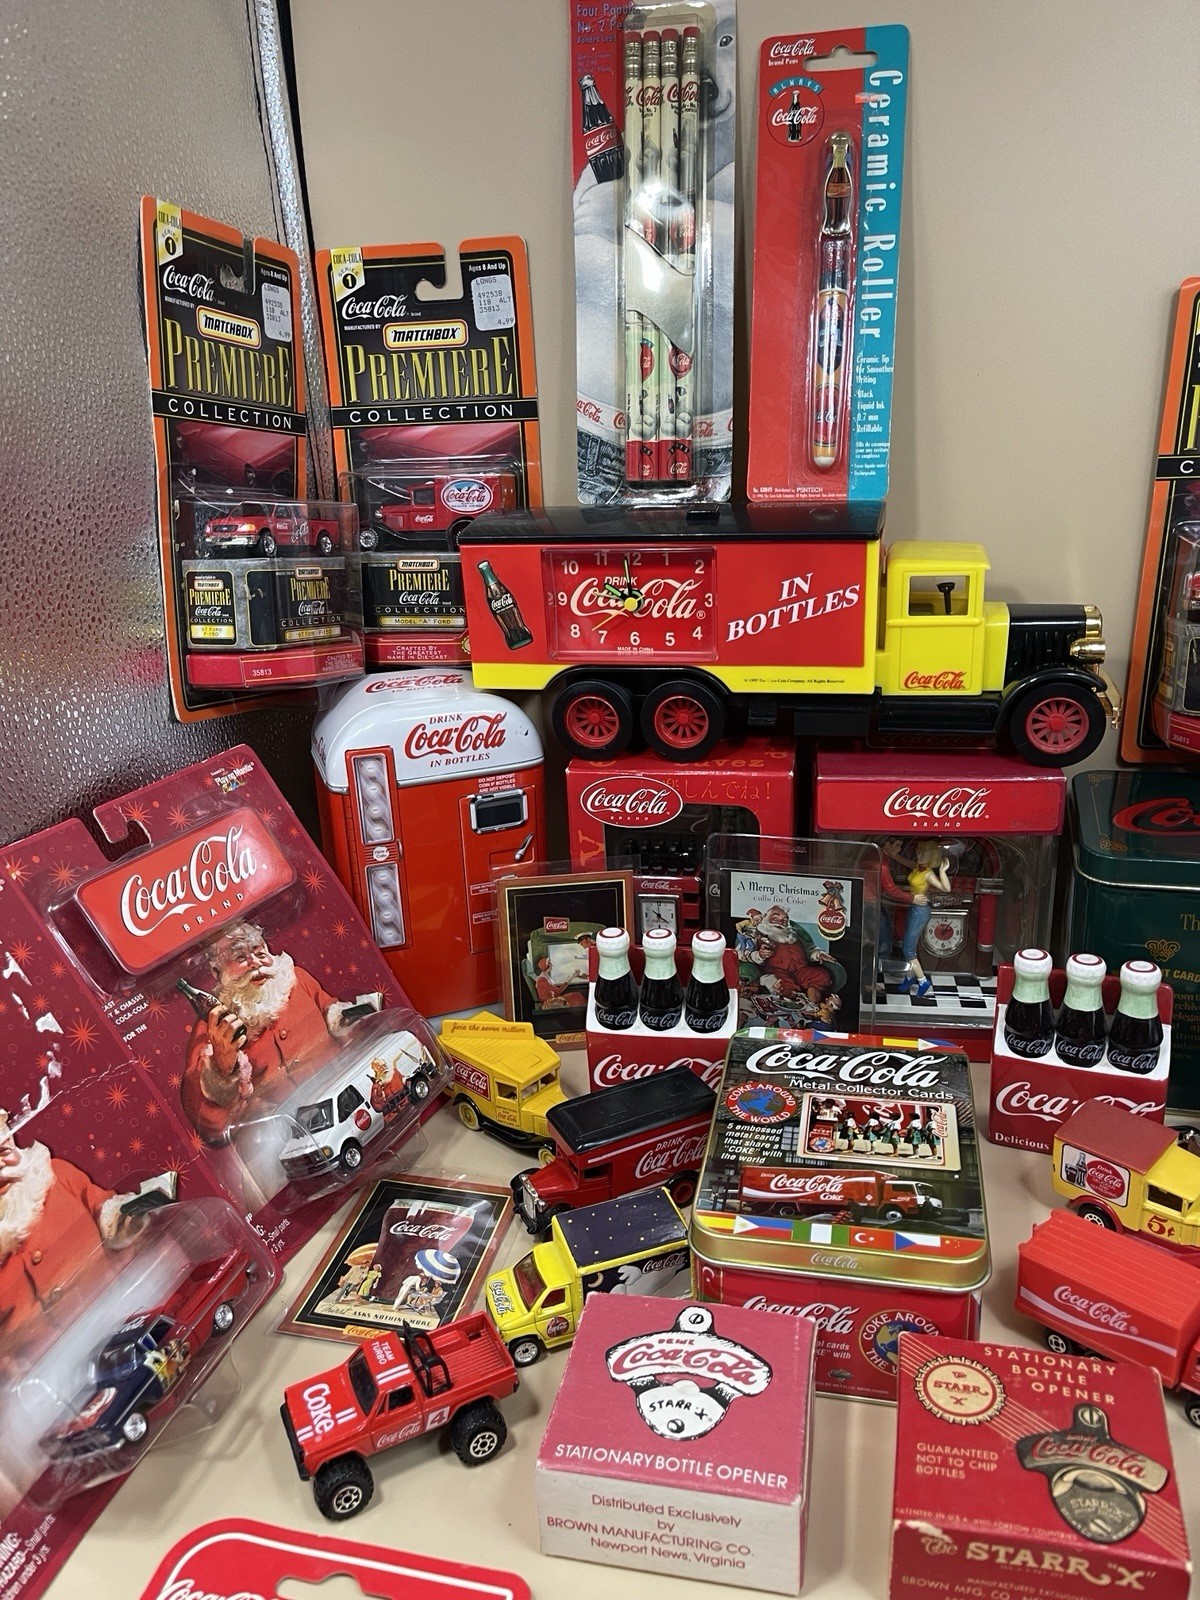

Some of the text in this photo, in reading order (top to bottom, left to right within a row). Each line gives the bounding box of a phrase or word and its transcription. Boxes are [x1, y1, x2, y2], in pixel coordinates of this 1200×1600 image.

[576, 5, 598, 17] Four
[770, 38, 816, 58] Coca-Cola
[773, 78, 819, 95] ALWAYS
[771, 106, 819, 127] Coca-Cola
[860, 70, 904, 339] Ceramic Roller
[332, 253, 363, 265] COCA-COLA
[468, 262, 506, 272] Ages And Up
[163, 264, 215, 303] Coca-Cola
[475, 276, 498, 286] LONGS
[477, 290, 503, 299] 492538
[478, 296, 512, 306] 118 ALT
[341, 294, 408, 320] Coca-Cola
[479, 305, 501, 314] 35813
[202, 313, 254, 340] MATCHBOX
[497, 317, 515, 326] 4.99
[279, 331, 291, 339] 4.99
[391, 327, 458, 343] MATCHBOX
[164, 318, 293, 407] PREMIERE
[856, 355, 880, 364] Ceramic
[343, 336, 514, 403] PREMIERE
[866, 365, 895, 374] Smoother
[855, 375, 877, 385] Writing
[857, 389, 874, 399] Black
[857, 401, 885, 410] Liquid Ink
[168, 398, 293, 430] COLLECTION
[349, 404, 514, 424] COLLECTION
[856, 424, 883, 433] Refillable
[401, 560, 435, 569] MATCHBOX
[561, 559, 705, 575] 10 2
[594, 552, 669, 566] 11 1
[389, 569, 450, 592] PREMIERE
[604, 576, 638, 586] DRINK
[778, 573, 814, 602] IN
[189, 588, 232, 606] PREMIERE
[399, 591, 441, 606] Coca-Cola
[557, 592, 713, 608] 9 3
[194, 605, 222, 617] Coca-Cola
[375, 606, 466, 614] COLLECTION
[725, 584, 861, 643] BOTTLES
[394, 617, 451, 625] MODEL FORD
[570, 624, 703, 646] 8 7 6 5 4
[252, 668, 273, 677] 35813
[904, 670, 967, 691] Coca-Cola
[429, 713, 463, 725] DRINK
[404, 711, 507, 760] Coca-Cola
[430, 752, 491, 768] IN BOTTLES
[495, 778, 516, 786] BOTTLES
[586, 787, 671, 815] Coca-Cola
[883, 786, 993, 819] Coca-Cola
[121, 825, 257, 937] Coca-Cola
[641, 880, 670, 891] Coca-Cola
[737, 881, 746, 891] A
[748, 881, 775, 896] Merry
[778, 883, 820, 897] Christmas
[773, 895, 785, 903] for
[786, 896, 807, 905] Coke
[182, 893, 245, 933] BRAND
[819, 914, 843, 924] Coca-Cola
[941, 915, 949, 923] 12
[597, 1009, 638, 1026] Coca-Cola
[136, 1024, 148, 1035] THE
[450, 1022, 526, 1034] Join the seven million
[745, 1043, 949, 1089] Coca-Cola
[728, 1083, 796, 1107] COKE AROUND
[789, 1078, 955, 1101] Metal Collector Cards
[729, 1105, 791, 1124] THE WORLD
[725, 1131, 781, 1142] metal cards
[727, 1122, 783, 1135] 5 embossed
[655, 1135, 685, 1151] DRINK
[724, 1137, 743, 1145] that
[744, 1140, 771, 1148] share
[994, 1132, 1050, 1150] Delicious
[720, 1152, 766, 1164] the world
[762, 1150, 783, 1158] with
[769, 1173, 845, 1192] Coca-Cola
[819, 1193, 844, 1201] Coke
[389, 1220, 457, 1242] Coca-Cola
[642, 1252, 686, 1275] Coca-Cola
[810, 1251, 859, 1270] Coca-Cola
[1053, 1285, 1132, 1332] Coca-Cola
[353, 1311, 432, 1328] ASKS MORE
[657, 1338, 696, 1346] DRINK
[826, 1341, 850, 1351] cards
[371, 1341, 388, 1366] TURBO
[380, 1341, 396, 1362] TEAM
[833, 1351, 852, 1359] with
[612, 1343, 758, 1385] Coca-Cola
[984, 1346, 1118, 1377] STATIONARY
[1011, 1364, 1088, 1386] BOTTLE
[933, 1380, 989, 1397] STARR
[1031, 1381, 1116, 1406] OPENER
[302, 1383, 336, 1436] Coke
[649, 1399, 692, 1413] STARR
[376, 1410, 446, 1449] Coca-Cola 4
[916, 1442, 999, 1461] GUARANTEED
[1030, 1435, 1148, 1480] Coca-Cola
[554, 1443, 789, 1490] STATIONARY BOTTLE OPENER
[916, 1454, 998, 1472] NOT TO CHIP
[916, 1465, 966, 1480] BOTTLES
[591, 1494, 742, 1529] Distributed Exclusively
[894, 1507, 933, 1518] PATENTED
[656, 1519, 675, 1533] by
[547, 1516, 755, 1558] BROWN MANUFACTURING CO.
[590, 1537, 747, 1570] Newport News, Virginia
[966, 1541, 1112, 1587] STARR
[901, 1575, 950, 1591] BROWN
